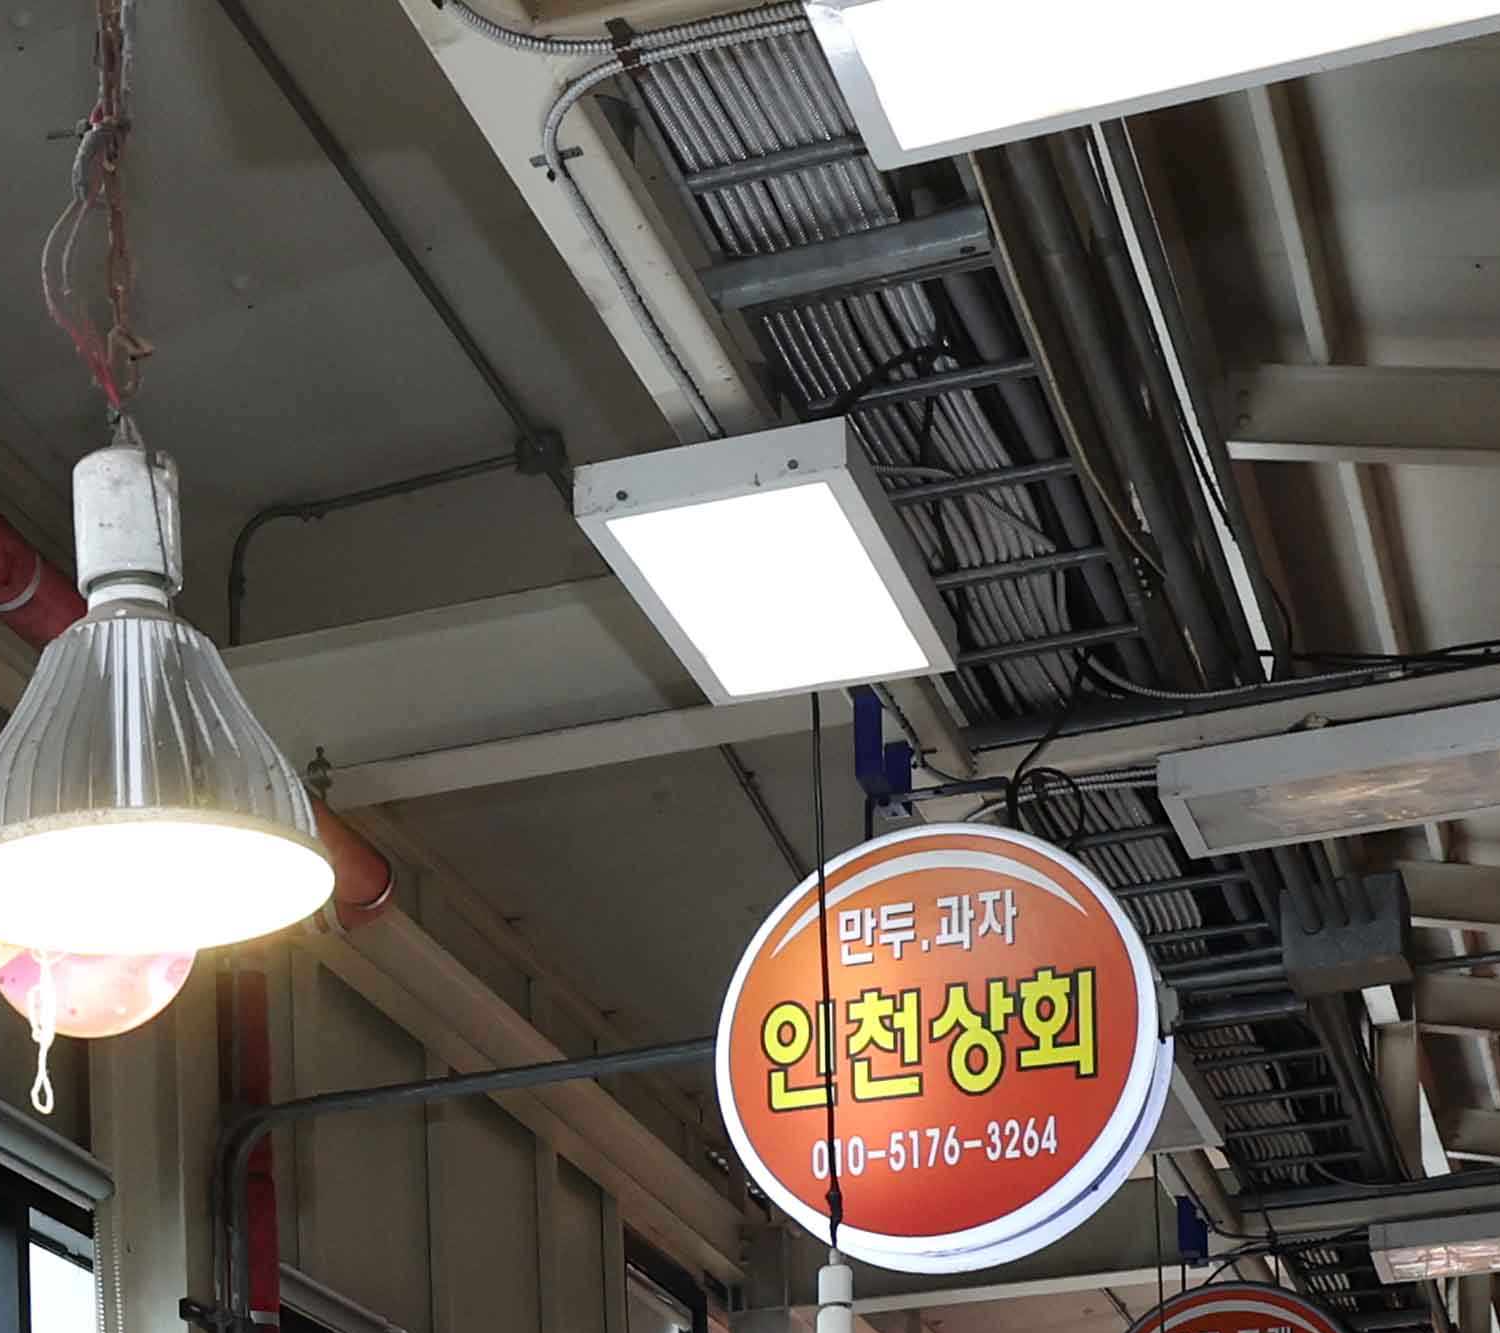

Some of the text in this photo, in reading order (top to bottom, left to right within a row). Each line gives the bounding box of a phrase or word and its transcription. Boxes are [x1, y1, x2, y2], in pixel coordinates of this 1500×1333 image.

[839, 889, 1019, 966] 만두.과자
[761, 965, 1097, 1113] 인천상회
[812, 1115, 1057, 1180] 010-5176-3264
